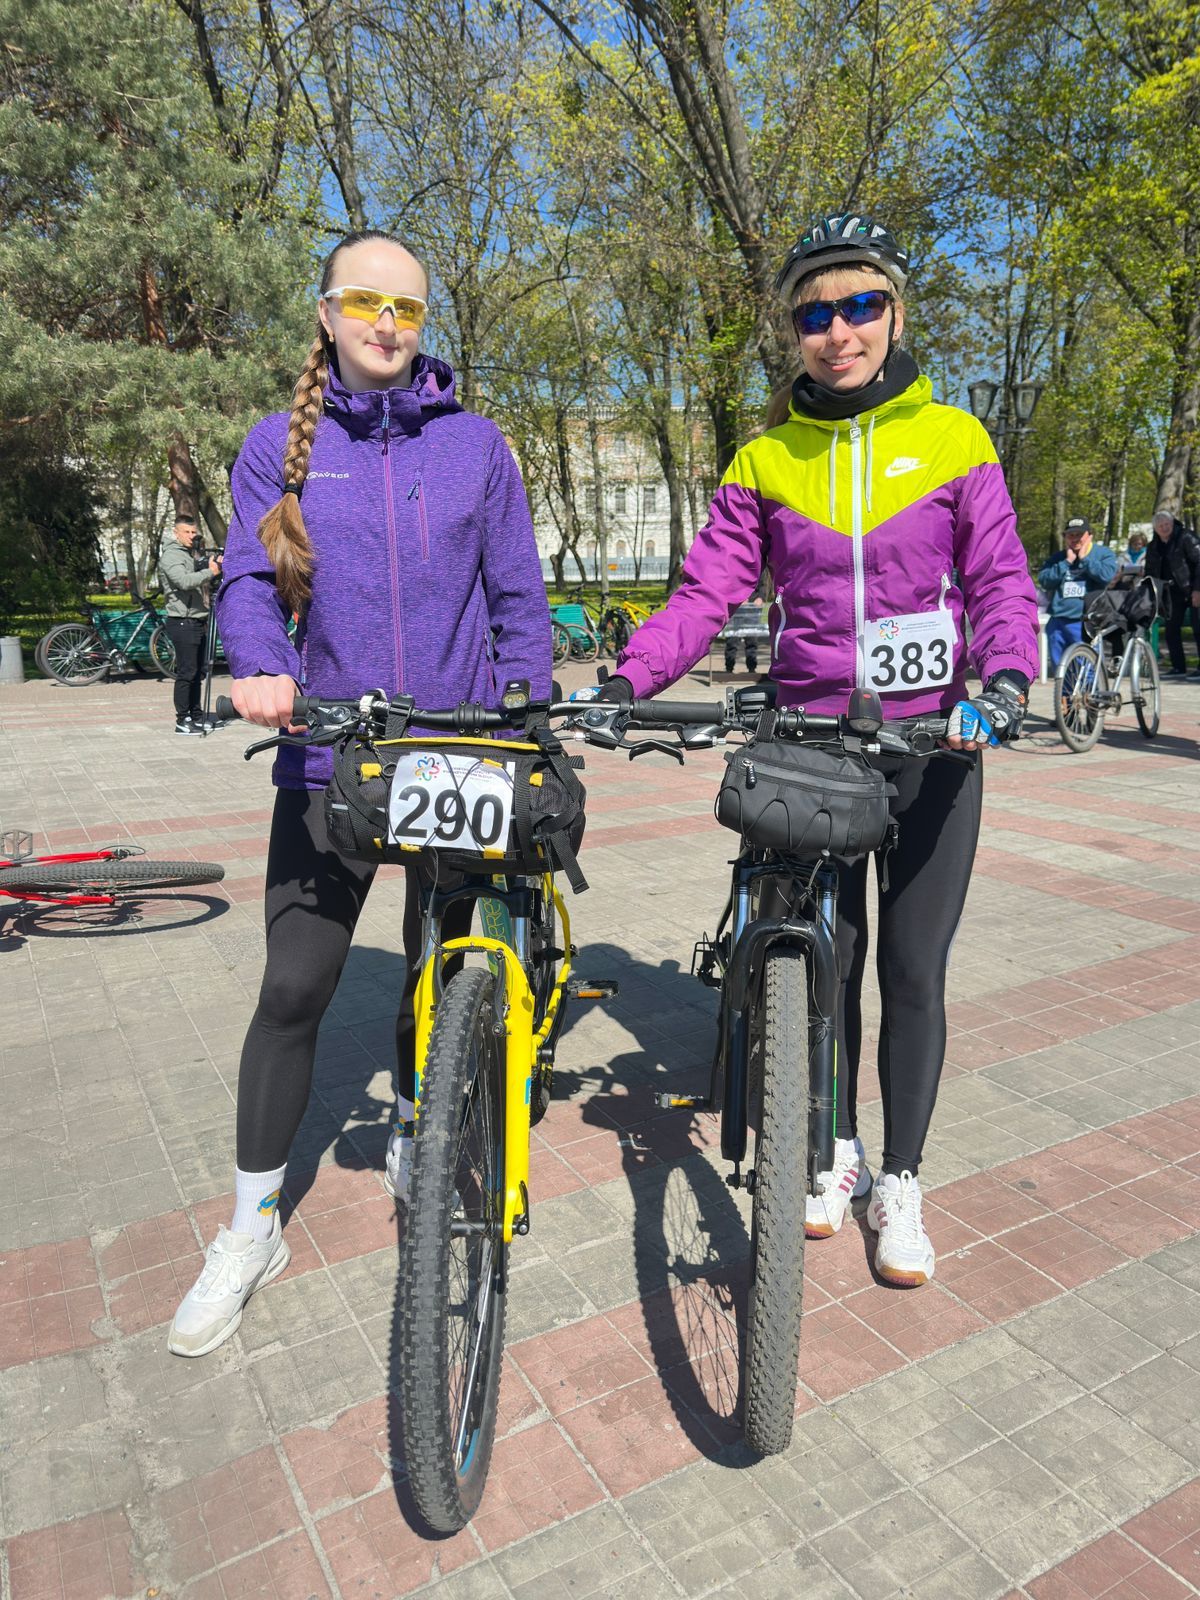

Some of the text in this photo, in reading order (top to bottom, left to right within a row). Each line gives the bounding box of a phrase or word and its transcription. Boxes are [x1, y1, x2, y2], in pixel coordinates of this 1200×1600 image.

[1064, 587, 1083, 596] 380
[871, 638, 949, 687] 383
[394, 785, 504, 846] 290
